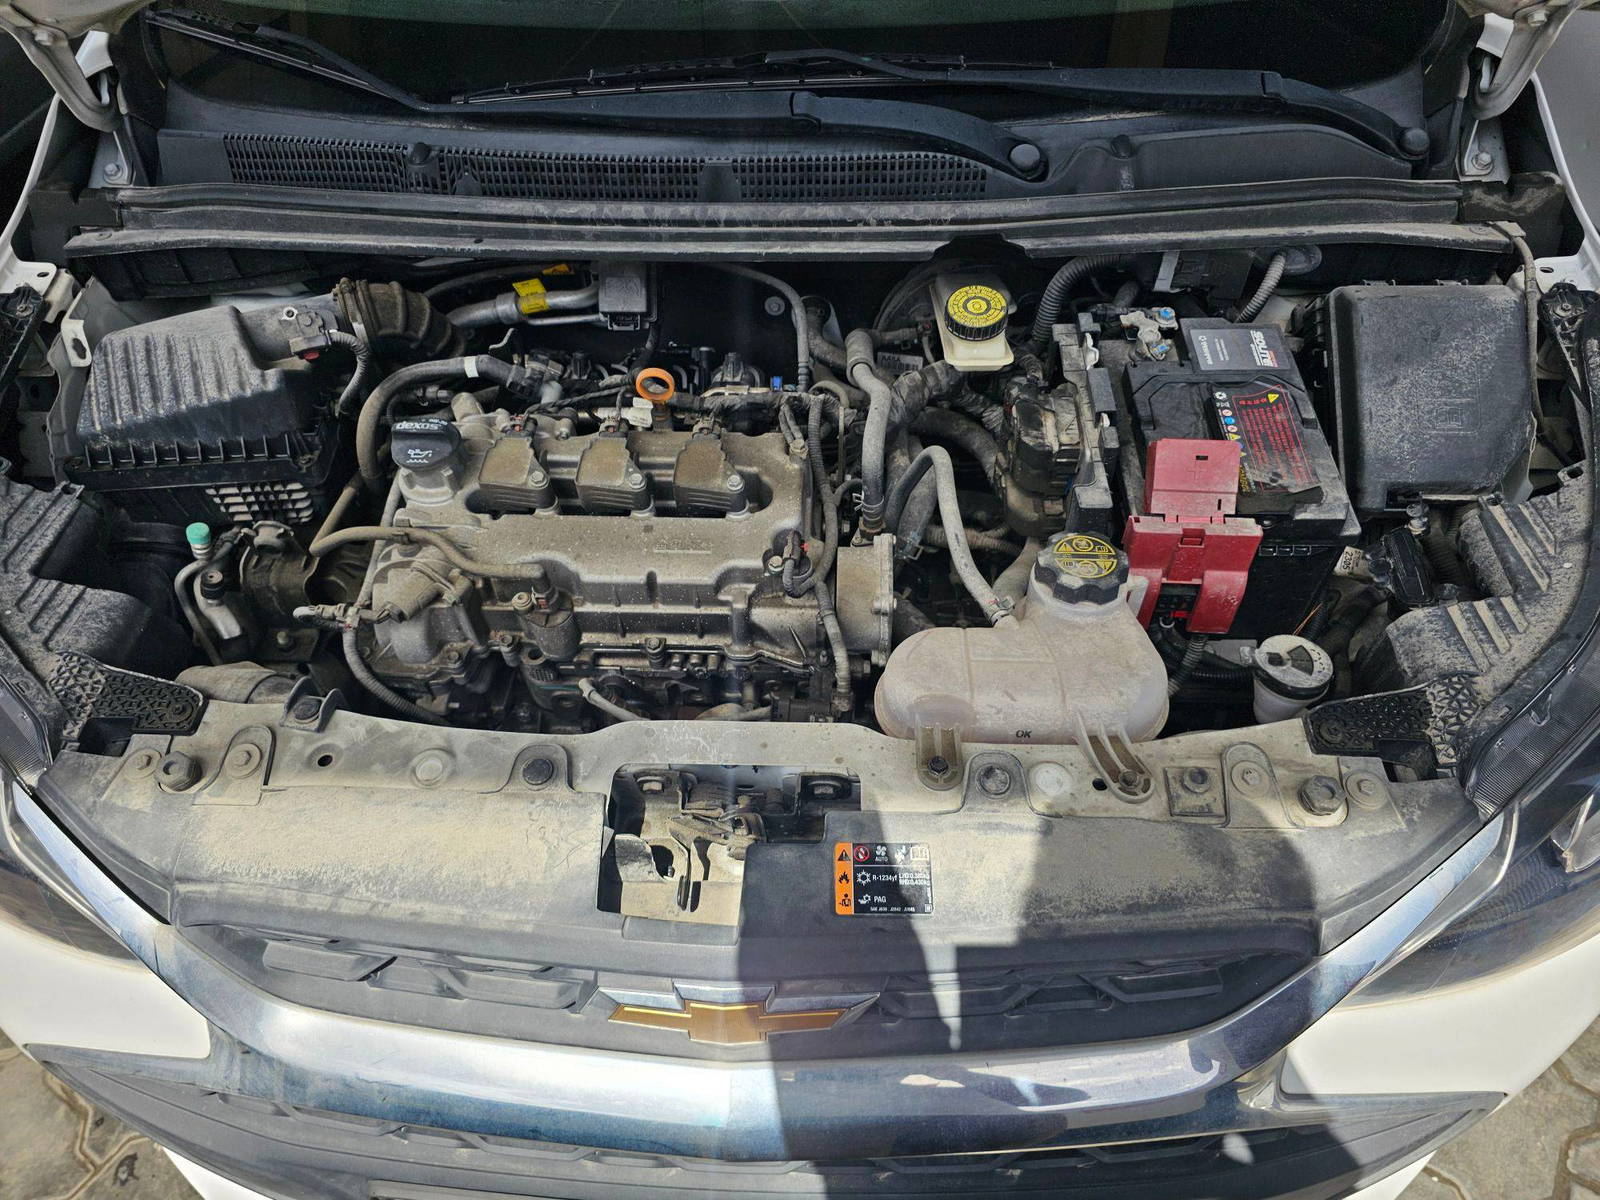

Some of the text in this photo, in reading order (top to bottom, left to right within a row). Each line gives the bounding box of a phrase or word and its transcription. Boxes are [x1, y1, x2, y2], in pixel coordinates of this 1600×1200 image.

[1253, 330, 1274, 367] SOLITE
[395, 421, 441, 430] dexos
[1015, 730, 1032, 739] OK
[873, 895, 887, 903] PAG
